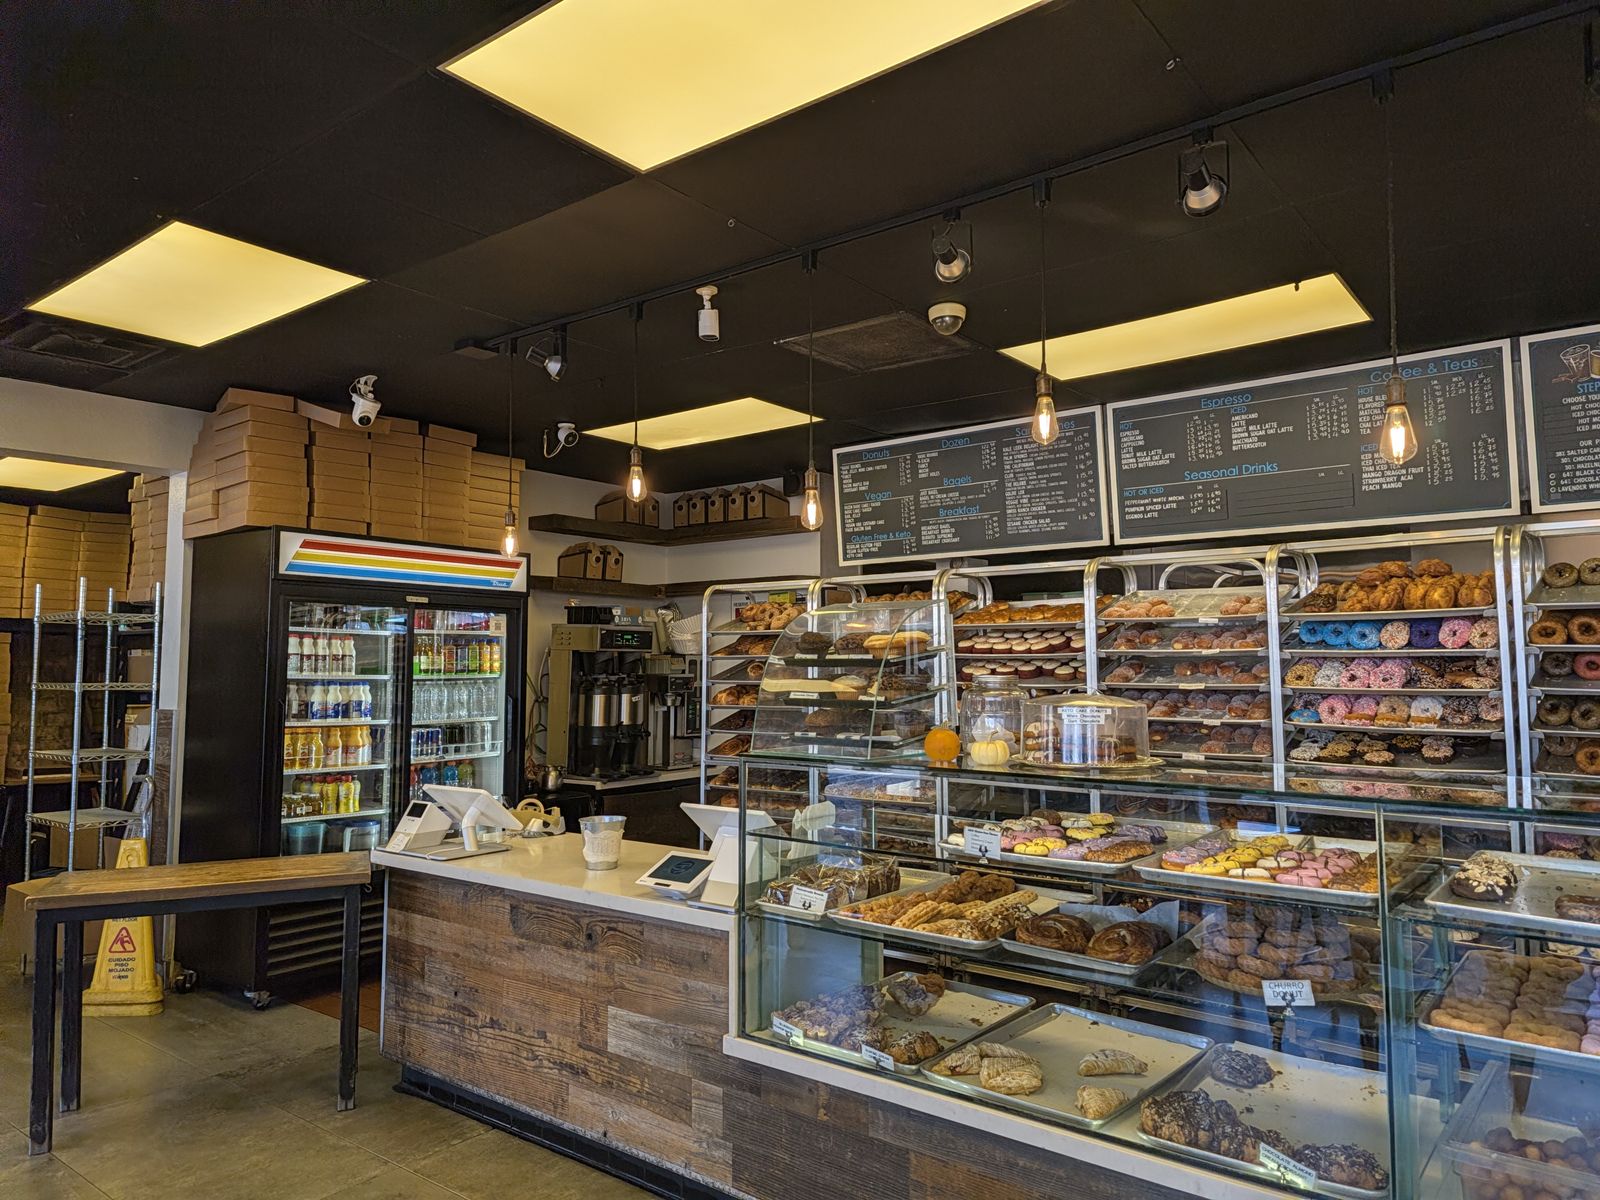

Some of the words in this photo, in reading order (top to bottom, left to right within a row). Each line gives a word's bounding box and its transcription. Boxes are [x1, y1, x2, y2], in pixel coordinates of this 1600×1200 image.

[1428, 363, 1437, 374] &
[1442, 358, 1478, 372] Teas
[1358, 388, 1373, 396] HOT
[1576, 382, 1600, 394] STEP
[1201, 394, 1252, 410] Espresso
[1562, 396, 1586, 404] CHOOSE
[1358, 402, 1384, 410] FLAVORED
[1232, 413, 1258, 422] AMERICANO
[1120, 430, 1140, 438] ESPRESSO
[942, 438, 970, 449] Dozen
[1120, 435, 1144, 443] AMERICANO
[1232, 438, 1258, 446] MACCHIATO
[1120, 440, 1144, 448] CAPPUCCINO
[1232, 442, 1267, 451] BUTTERSCOTCH
[1360, 444, 1378, 452] ICED
[862, 450, 890, 460] Donuts
[1138, 460, 1170, 468] BUTTERSCOTCH
[1185, 465, 1238, 480] Seasonal
[1242, 460, 1278, 474] Drinks
[1384, 469, 1406, 477] DRAGON
[1408, 466, 1424, 474] FRUIT
[944, 476, 972, 486] Bagels
[1362, 476, 1398, 485] STRAWBERRY
[1362, 483, 1380, 491] PEACH
[1558, 484, 1587, 492] LAVENDER
[864, 491, 892, 501] Vegan
[938, 504, 979, 516] Breakfast
[1268, 982, 1304, 990] CHURRO
[1262, 1146, 1290, 1164] CHOCOLATE
[1292, 1164, 1314, 1178] ALMOND
